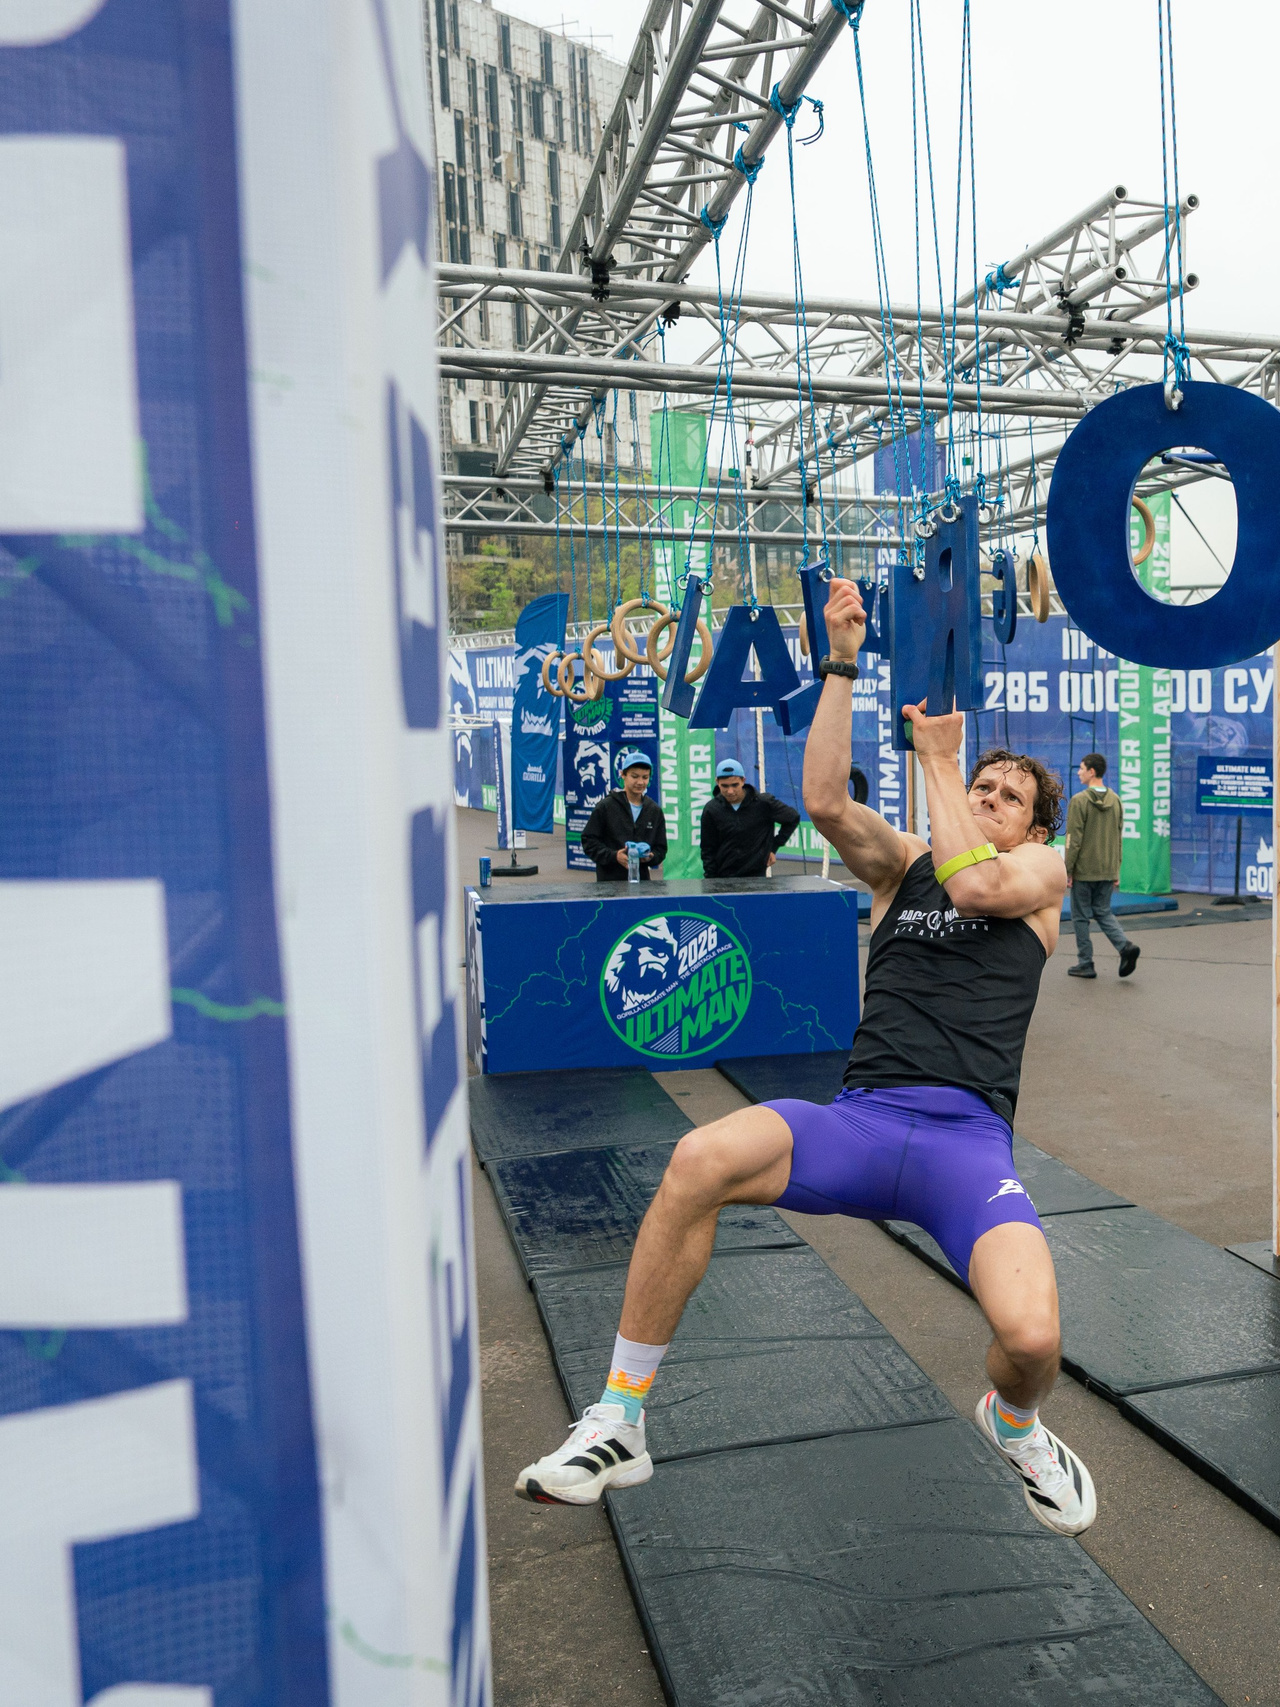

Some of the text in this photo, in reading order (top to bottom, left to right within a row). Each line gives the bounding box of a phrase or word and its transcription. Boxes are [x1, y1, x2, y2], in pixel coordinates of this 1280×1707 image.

[985, 670, 1048, 713] 285
[522, 771, 546, 783] GORILLA
[1121, 740, 1141, 839] POWER
[1216, 764, 1266, 774] ULTIMATE MAN
[678, 923, 718, 976] 2026
[616, 943, 733, 1020] GORILLA ULTIMATE MAN THE OBSTACLE RACE
[626, 948, 746, 1047] ULTIMATE
[681, 983, 746, 1053] MAN
